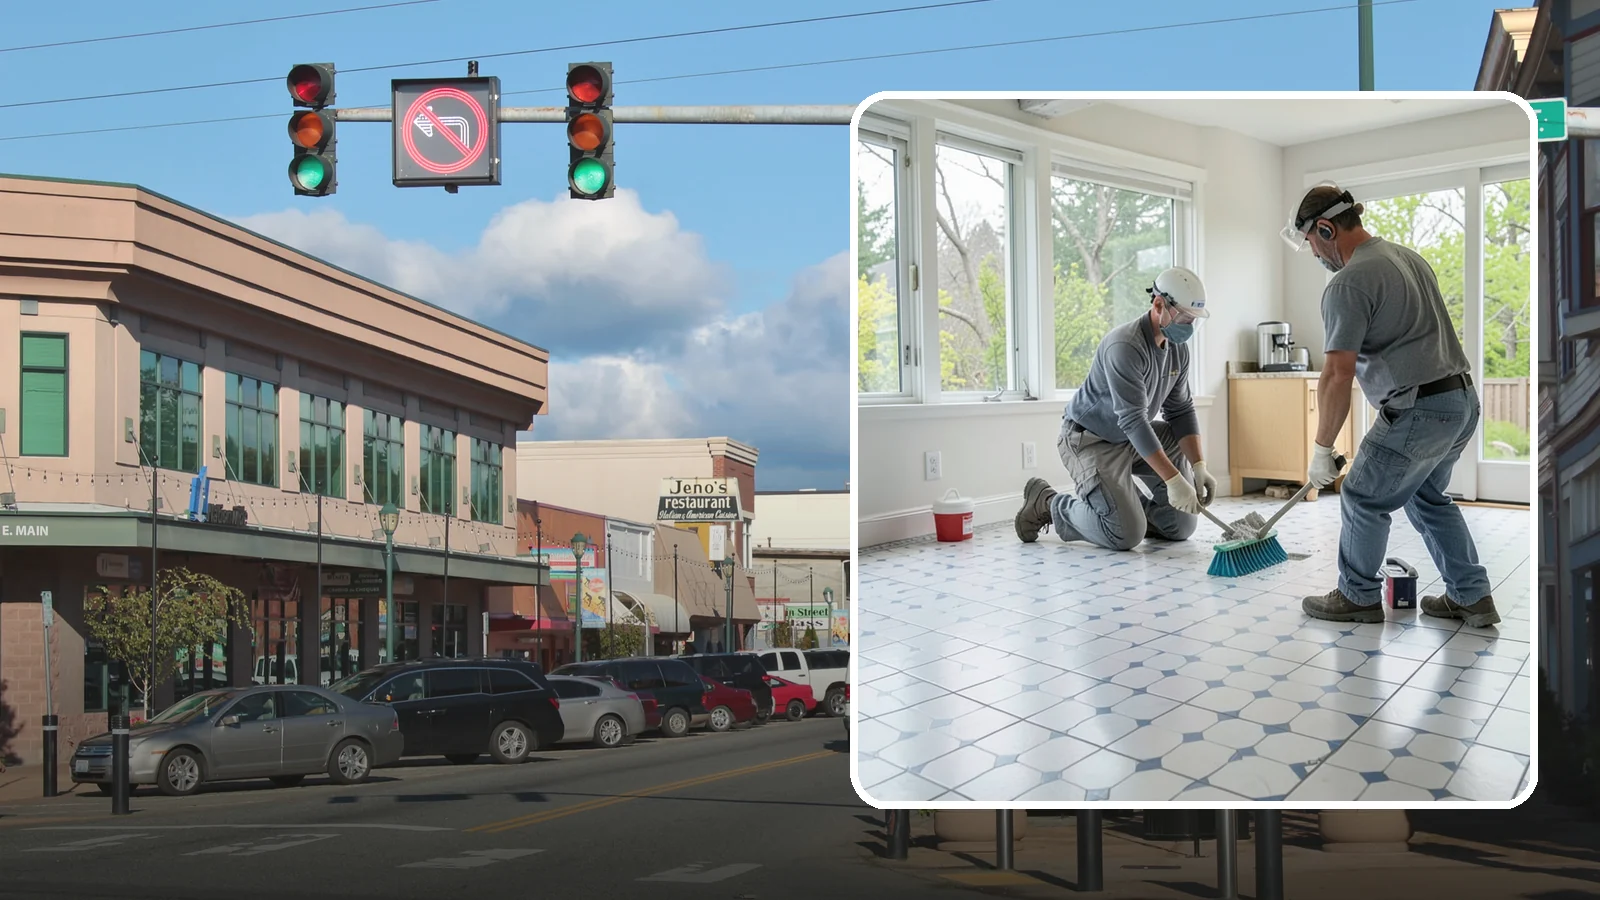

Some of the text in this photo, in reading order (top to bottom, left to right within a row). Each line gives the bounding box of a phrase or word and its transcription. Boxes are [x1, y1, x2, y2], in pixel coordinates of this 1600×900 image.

[670, 480, 728, 494] Jeno's
[665, 496, 731, 509] restaurant
[659, 510, 682, 519] Italian
[686, 510, 715, 519] American
[715, 509, 737, 519] Cuisine
[2, 525, 49, 536] E. MAIN
[797, 607, 828, 617] Street
[790, 618, 824, 627] lass
